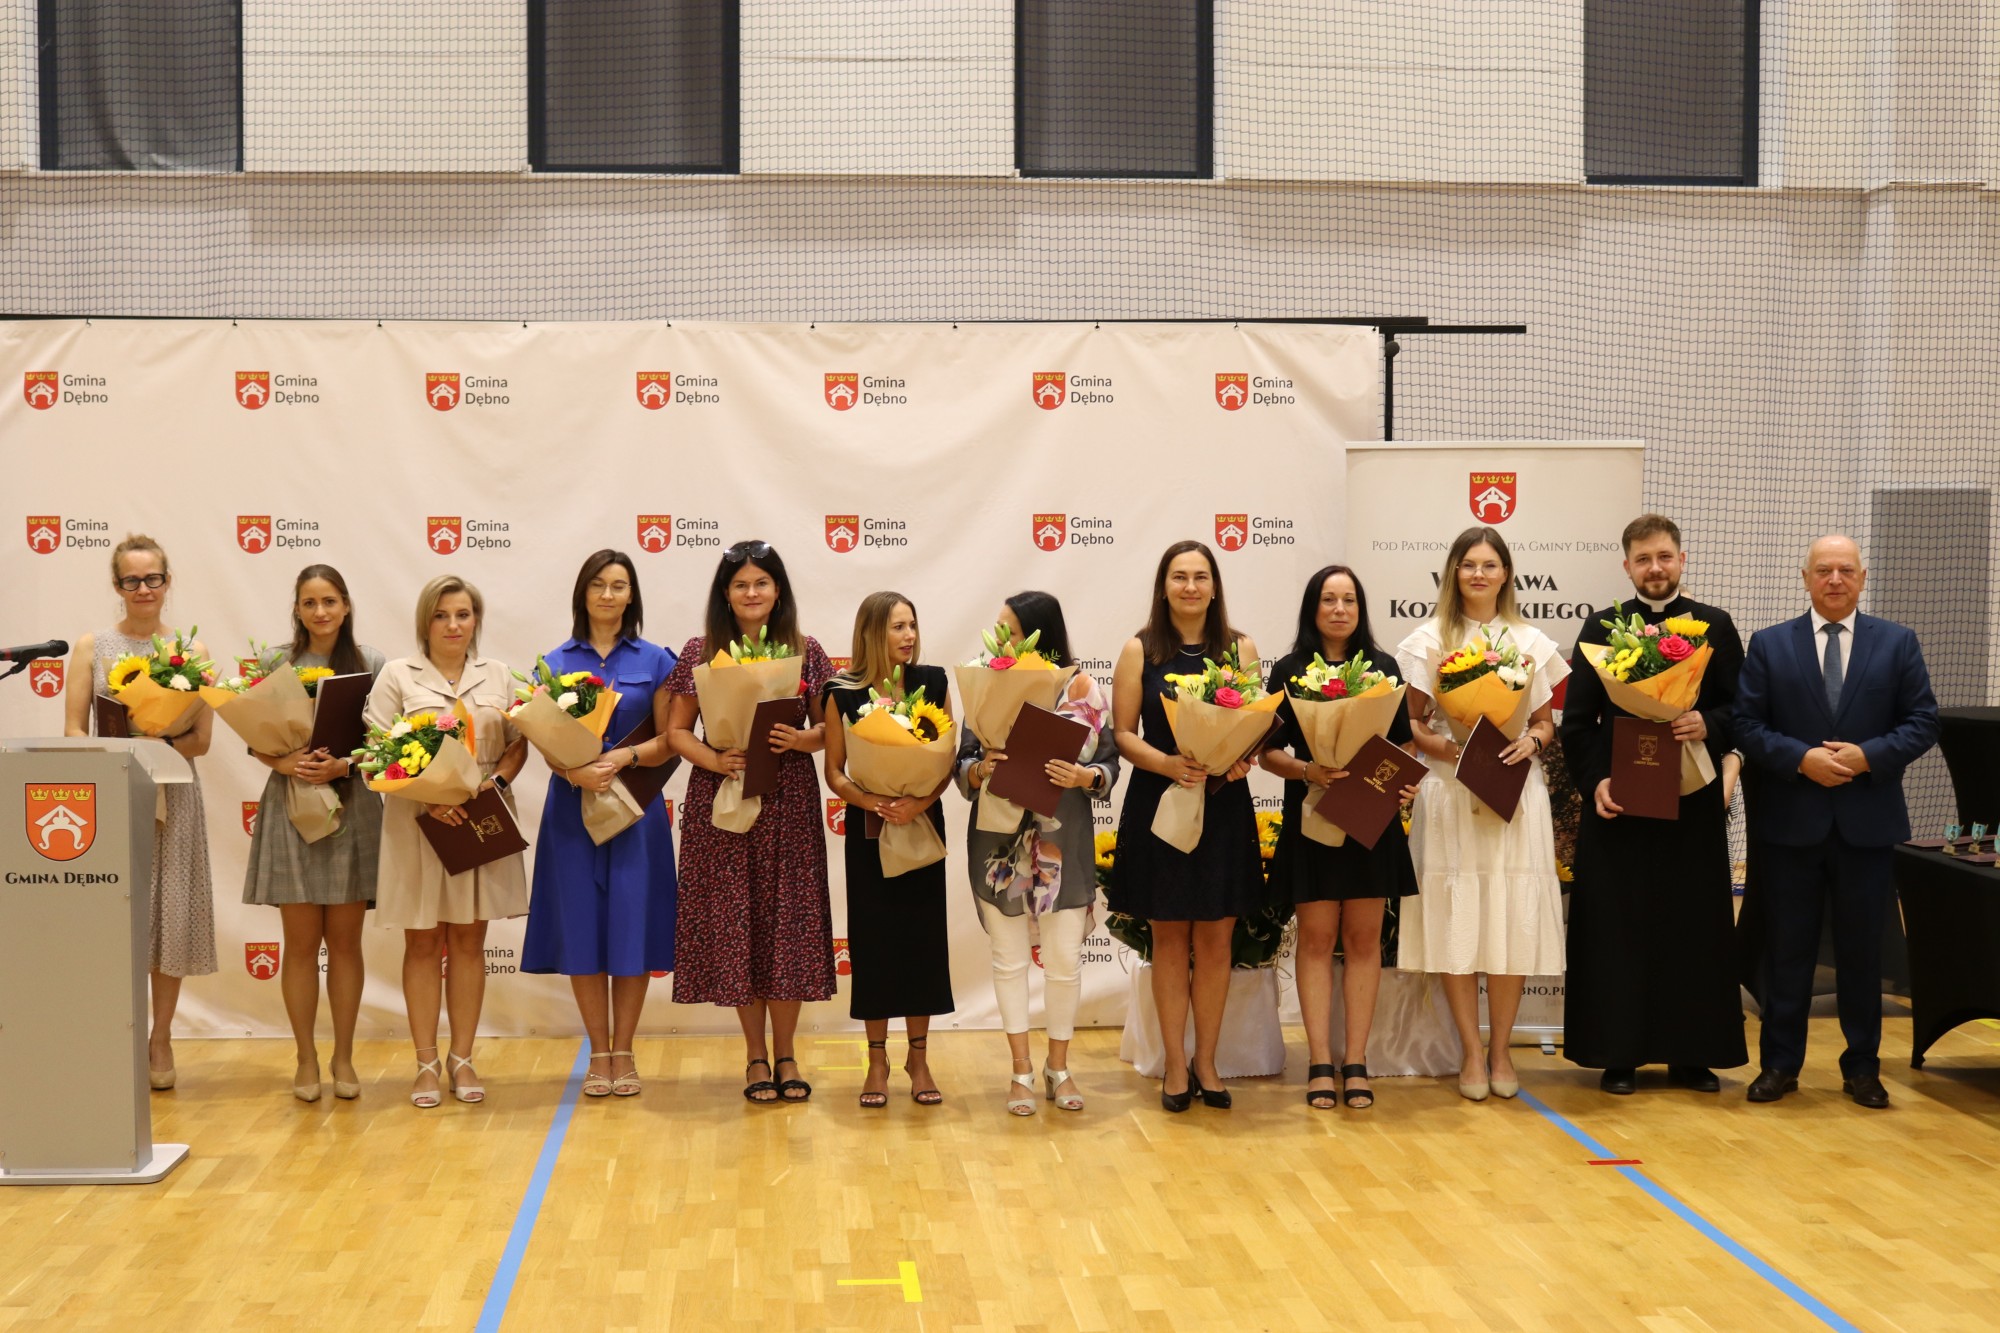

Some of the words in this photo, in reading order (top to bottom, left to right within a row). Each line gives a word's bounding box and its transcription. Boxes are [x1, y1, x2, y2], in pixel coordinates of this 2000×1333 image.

[62, 374, 106, 387] Gmina
[274, 374, 318, 387] Gmina
[464, 375, 508, 388] Gmina
[674, 374, 718, 387] Gmina
[862, 375, 906, 388] Gmina
[1070, 374, 1112, 387] Gmina
[1252, 376, 1294, 389] Gmina
[63, 390, 109, 406] Dębno
[274, 390, 320, 406] Dębno
[465, 391, 510, 407] Dębno
[675, 390, 720, 406] Dębno
[863, 391, 908, 407] Dębno
[1070, 390, 1114, 406] Dębno
[1253, 392, 1295, 407] Dębno
[65, 518, 109, 531] Gmina
[275, 518, 319, 531] Gmina
[465, 519, 510, 532] Gmina
[675, 517, 719, 530] Gmina
[863, 517, 906, 531] Gmina
[1070, 516, 1113, 529] Gmina
[1252, 516, 1294, 529] Gmina
[66, 534, 111, 550] Dębno
[276, 534, 321, 550] Dębno
[466, 535, 512, 551] Dębno
[676, 533, 721, 549] Dębno
[863, 533, 908, 549] Dębno
[1070, 532, 1114, 548] Dębno
[1252, 532, 1295, 548] Dębno
[1372, 541, 1398, 551] POD
[1401, 541, 1453, 551] PATRON
[1528, 541, 1573, 552] GMINY
[1576, 541, 1620, 554] DĘBNO
[1092, 800, 1112, 809] ina
[1251, 795, 1284, 808] Gmin
[5, 872, 60, 884] GMINA
[63, 872, 119, 887] DĘBNO
[1083, 934, 1111, 947] mina
[484, 946, 514, 958] mina
[1080, 950, 1113, 965] ębno
[484, 961, 516, 977] ębno
